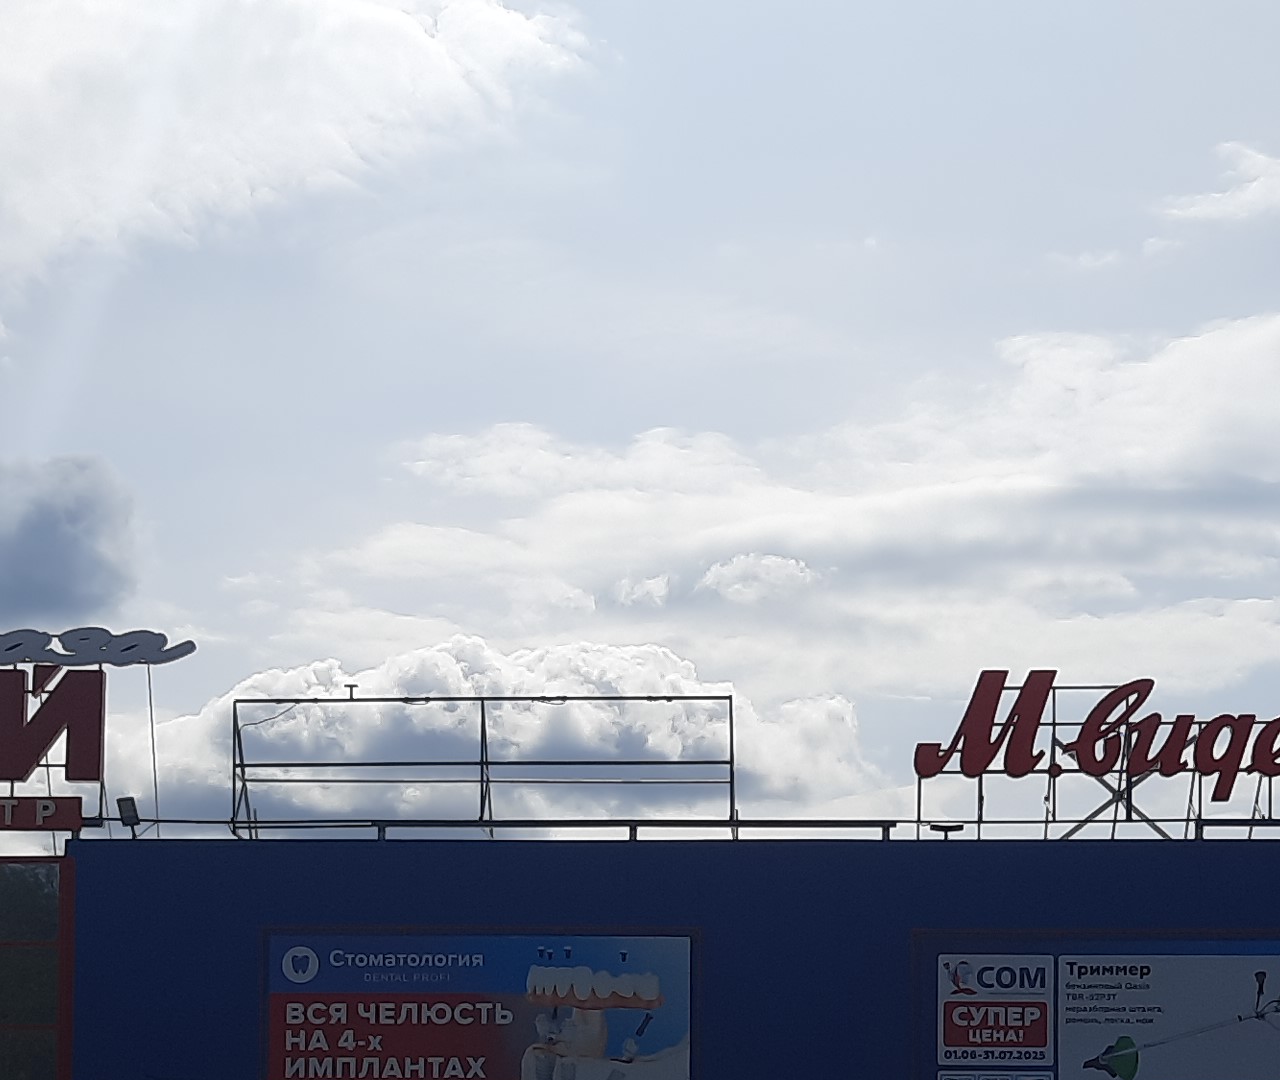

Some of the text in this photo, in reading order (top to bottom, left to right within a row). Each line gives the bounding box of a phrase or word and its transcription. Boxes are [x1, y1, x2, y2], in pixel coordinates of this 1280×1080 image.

[329, 950, 485, 969] Стоматология
[363, 972, 408, 982] DENTAL
[1065, 961, 1152, 980] Триммер
[285, 1002, 515, 1026] ВСЯ ЧЕЛЮСТЬ
[951, 1006, 1042, 1027] СУПЕР
[285, 1030, 384, 1052] НА 4-х
[967, 1028, 1025, 1044] ЦЕНА!
[285, 1056, 487, 1080] ИМПЛАНТАХ
